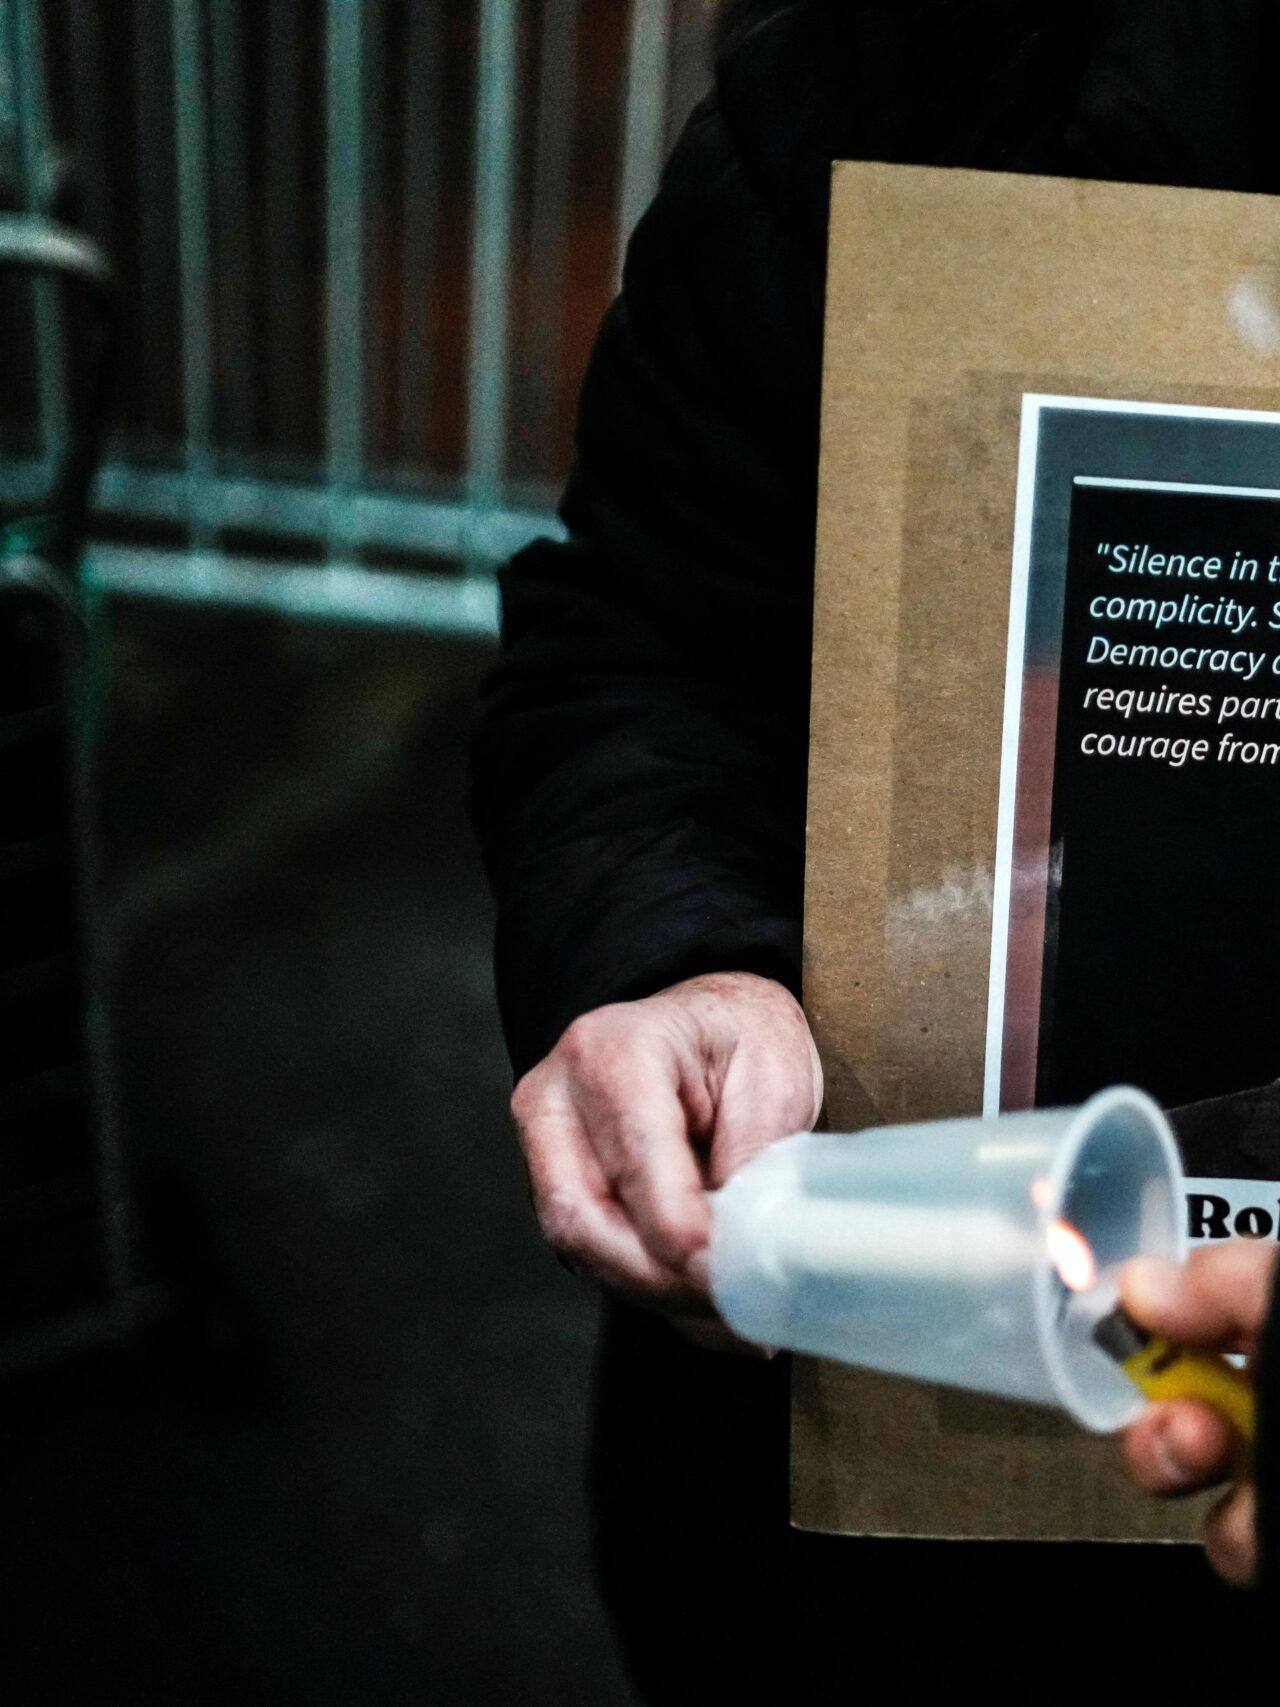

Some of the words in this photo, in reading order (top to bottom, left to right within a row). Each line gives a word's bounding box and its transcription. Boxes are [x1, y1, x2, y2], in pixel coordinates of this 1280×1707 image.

[1097, 542, 1222, 580] "Silence
[1229, 551, 1259, 582] in
[1089, 593, 1257, 634] complicity.
[1086, 635, 1267, 681] Democracy
[1082, 684, 1212, 719] requires
[1080, 732, 1210, 768] courage
